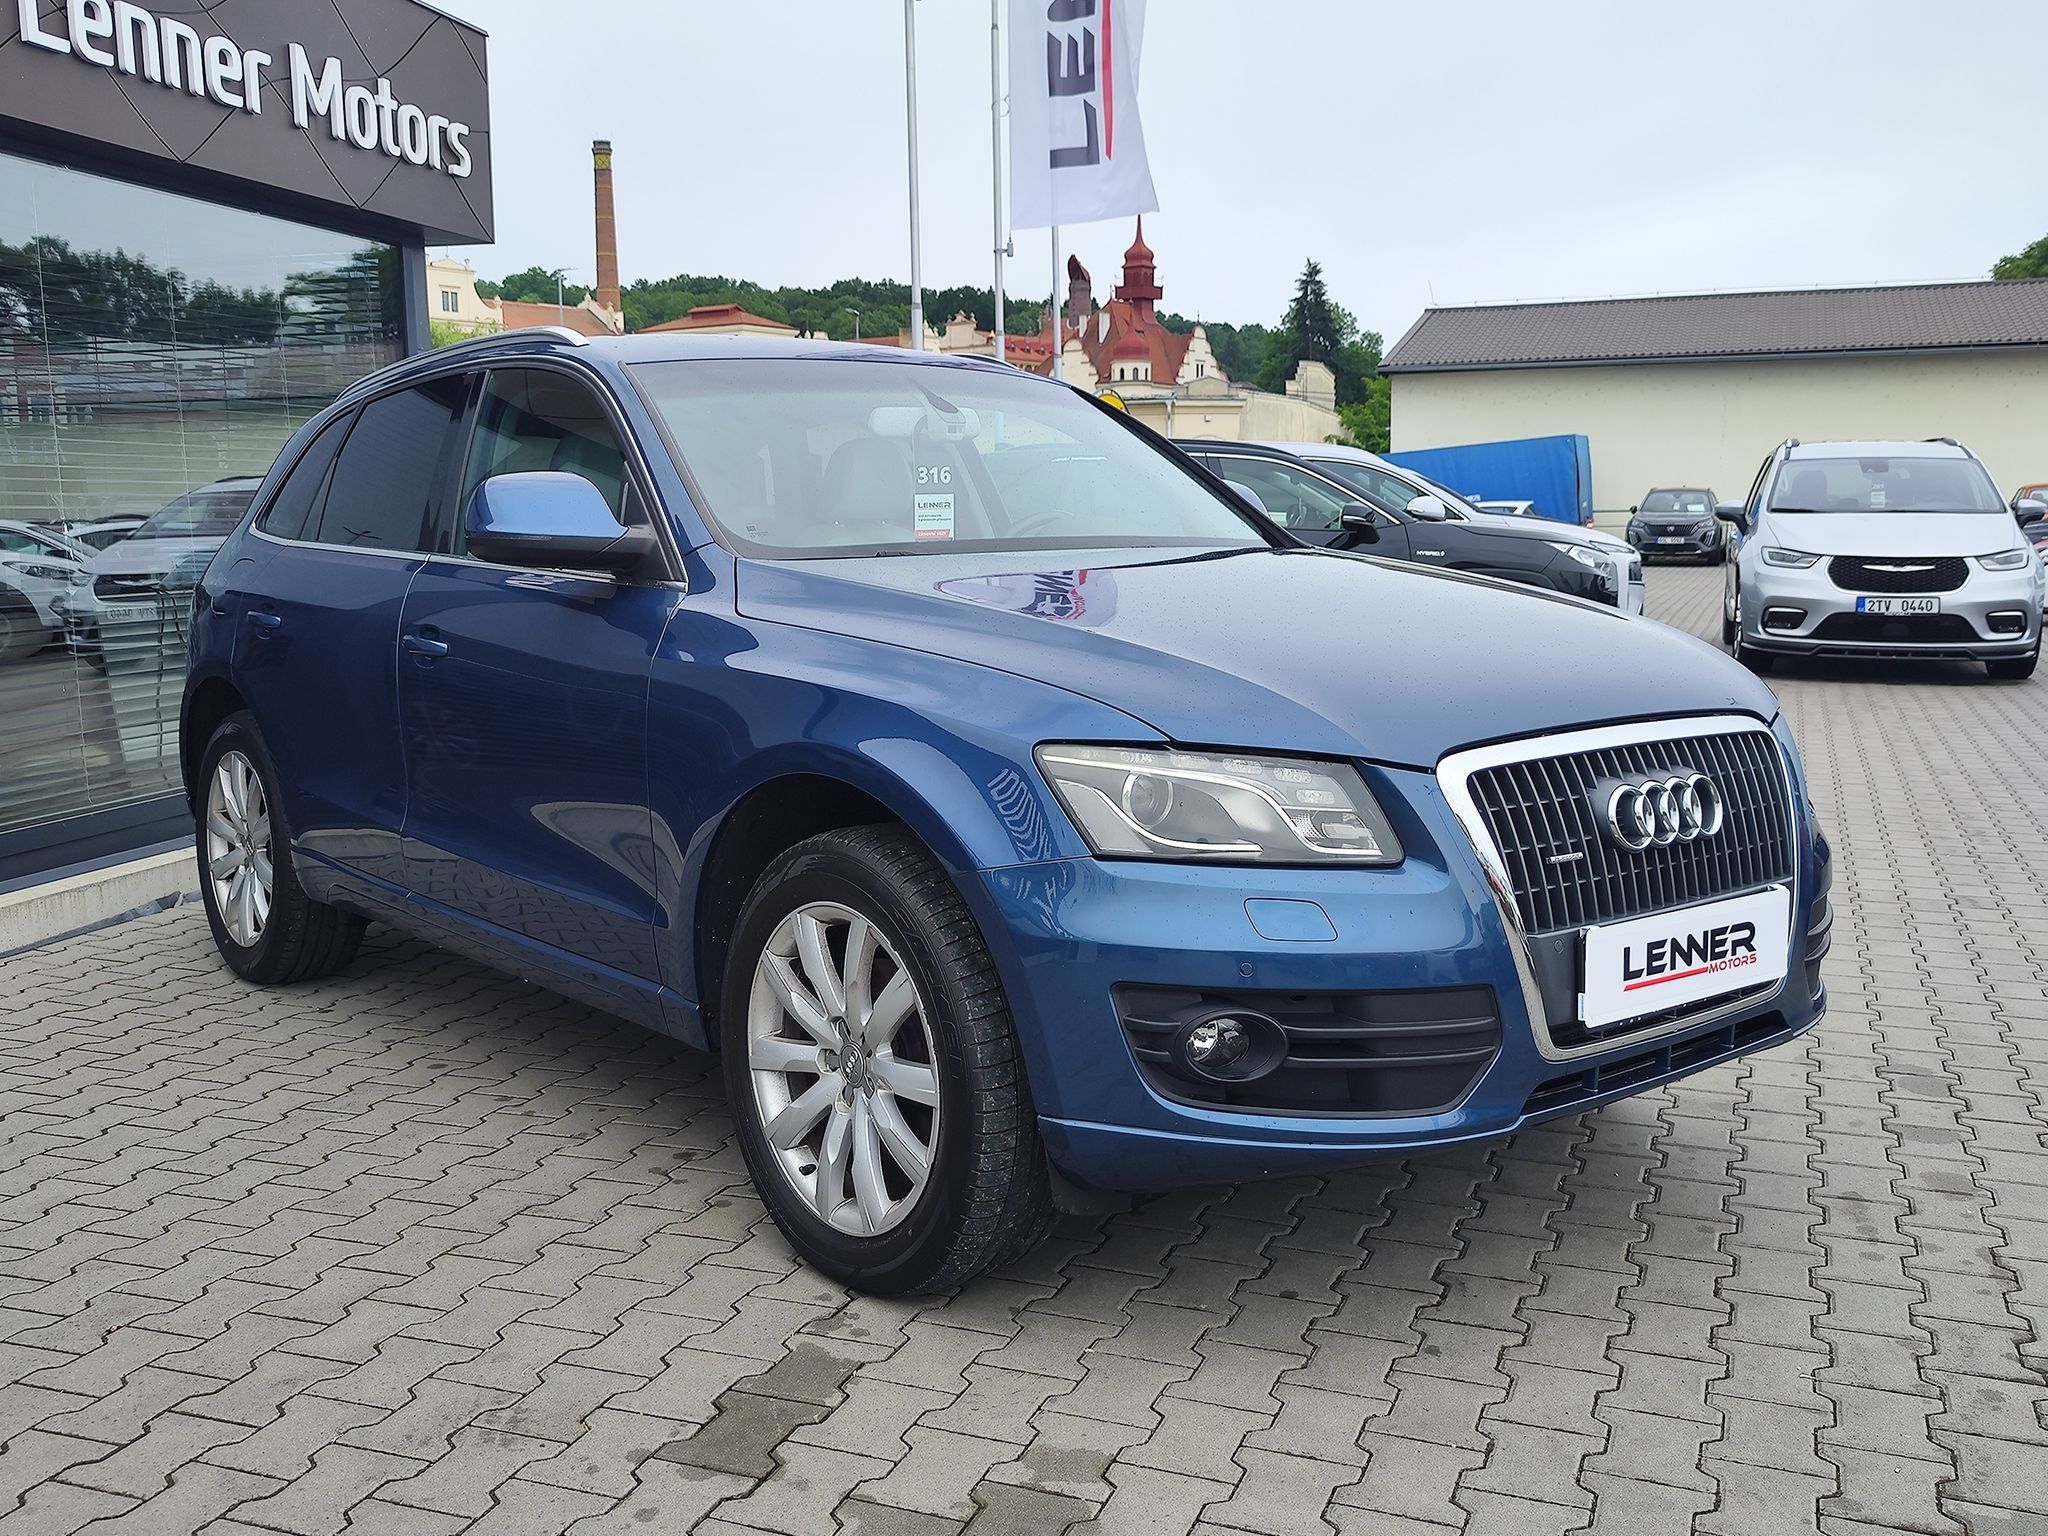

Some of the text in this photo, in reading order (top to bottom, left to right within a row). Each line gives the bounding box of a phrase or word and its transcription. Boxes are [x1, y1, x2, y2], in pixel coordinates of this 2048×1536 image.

[288, 42, 472, 178] Motors
[917, 466, 951, 484] 316
[1868, 600, 1891, 611] 2TV
[1902, 600, 1933, 611] 0440
[1623, 921, 1757, 981] LENNER
[1709, 953, 1757, 974] MOTORS
